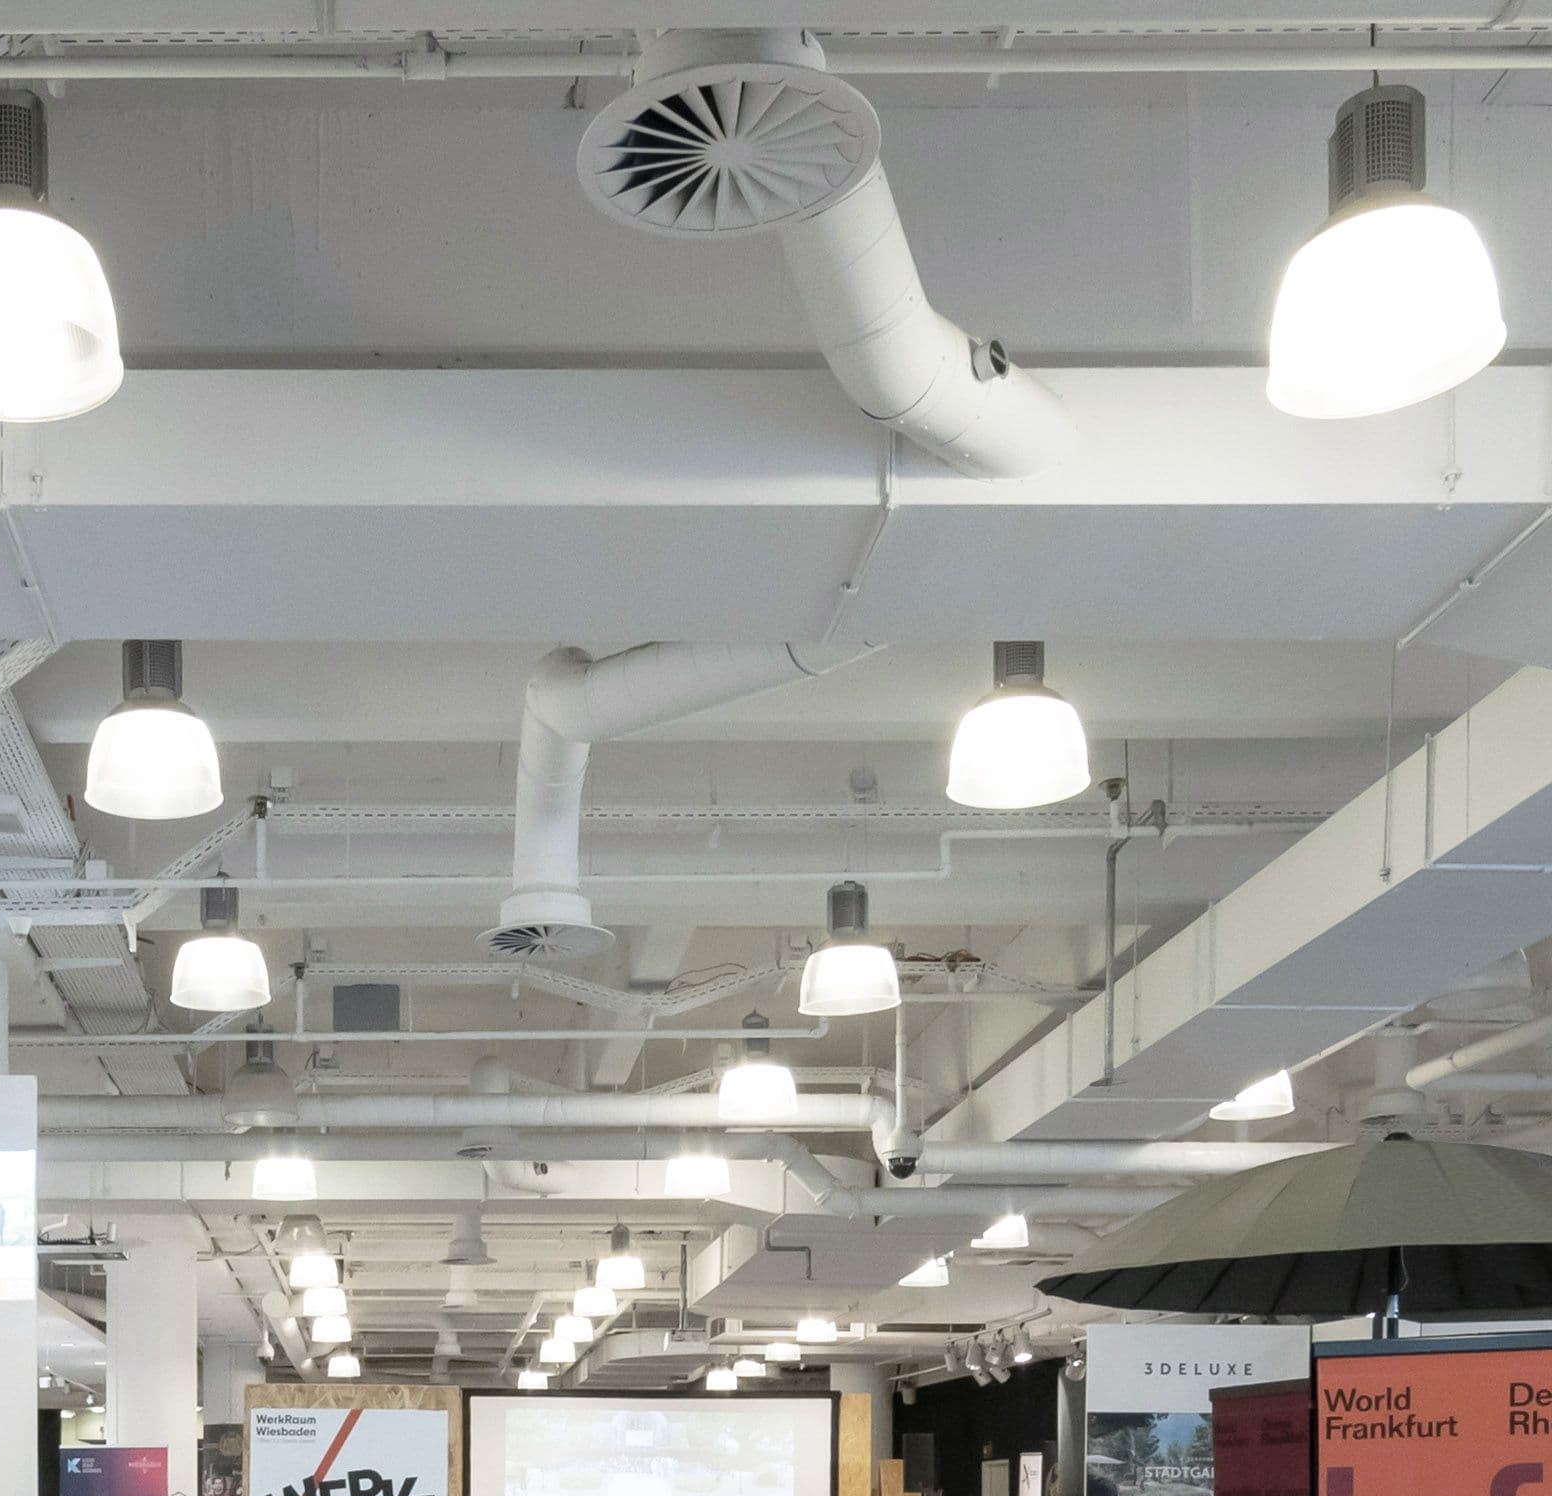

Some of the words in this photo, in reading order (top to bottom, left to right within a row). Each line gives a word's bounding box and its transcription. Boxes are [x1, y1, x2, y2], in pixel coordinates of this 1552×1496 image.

[1145, 1363, 1253, 1375] 3DELUXE
[1324, 1387, 1411, 1412] World
[1510, 1382, 1552, 1407] De
[256, 1415, 316, 1424] WerkRaum
[1325, 1414, 1458, 1440] Frankfurt
[1510, 1410, 1552, 1436] Rh
[256, 1426, 316, 1436] Wiesbaden
